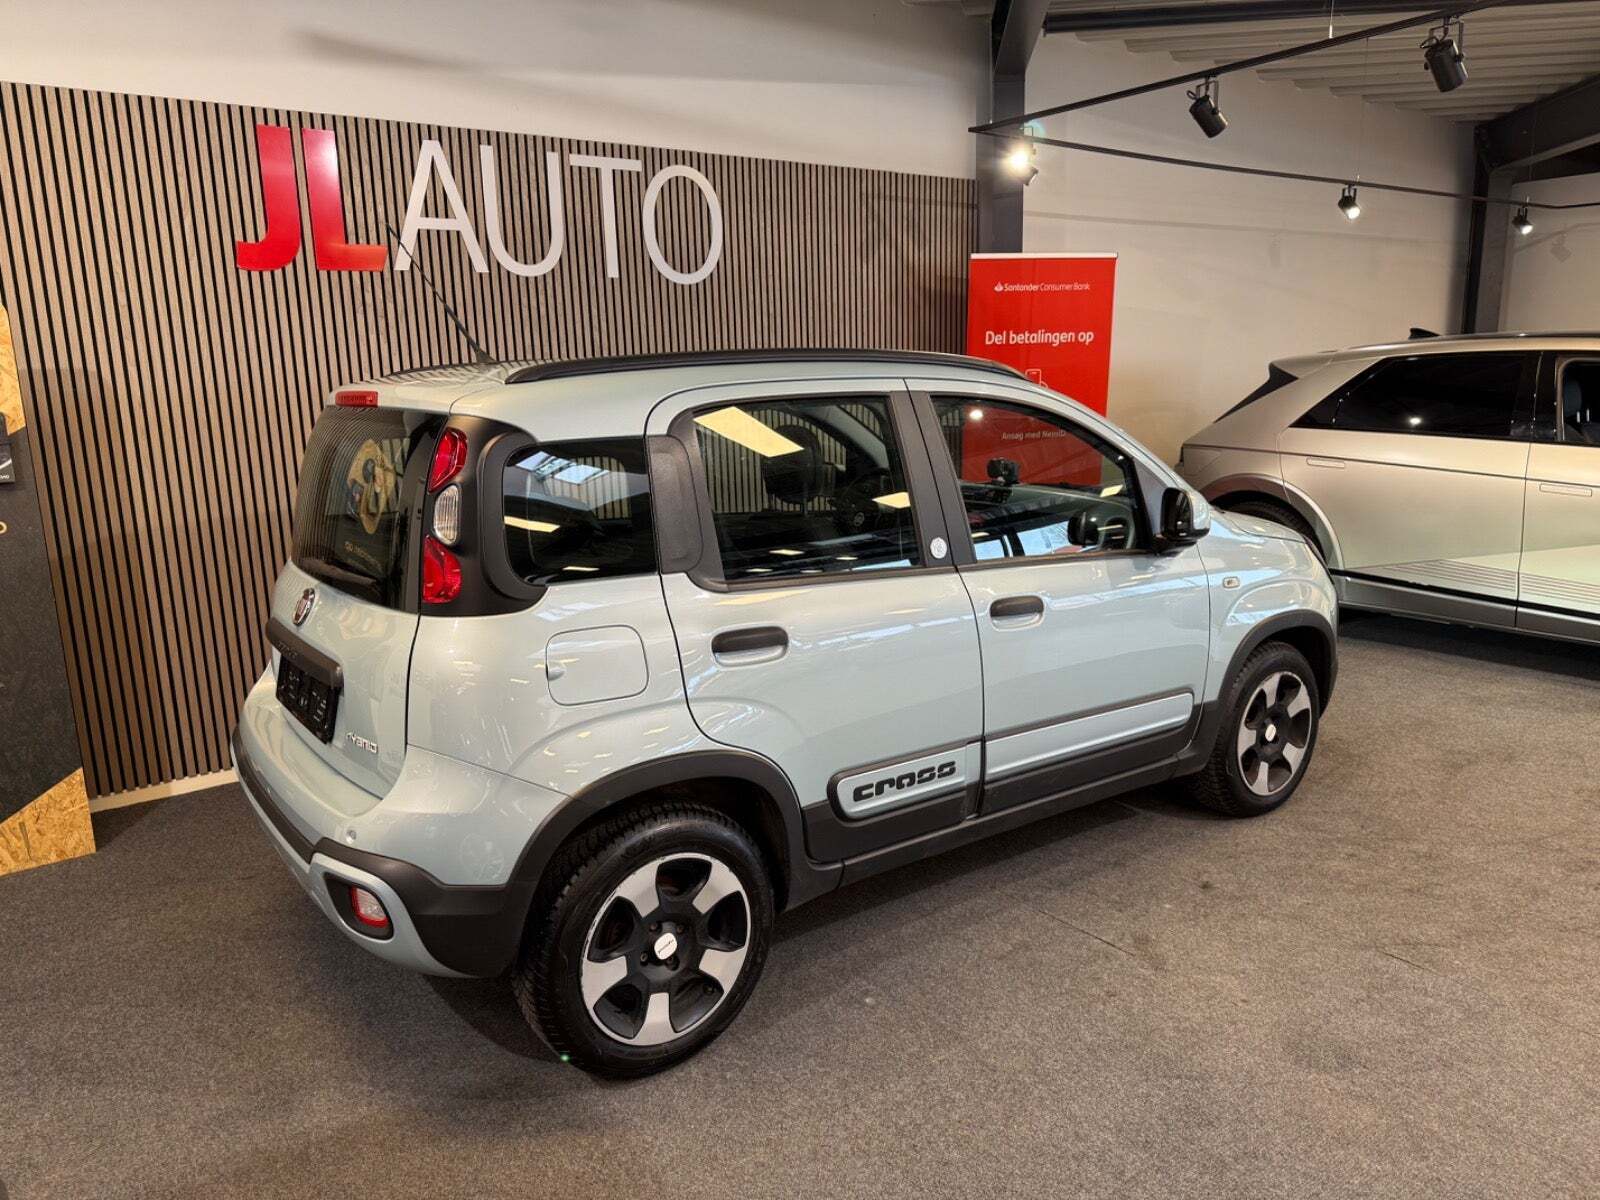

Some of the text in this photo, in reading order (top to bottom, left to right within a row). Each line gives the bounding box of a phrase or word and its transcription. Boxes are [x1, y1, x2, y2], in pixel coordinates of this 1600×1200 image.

[236, 124, 723, 285] JL AUTO
[1004, 282, 1040, 292] Santander
[985, 329, 1094, 347] Del betalingen op
[1002, 432, 1024, 440] Ansøg
[1024, 431, 1041, 439] med
